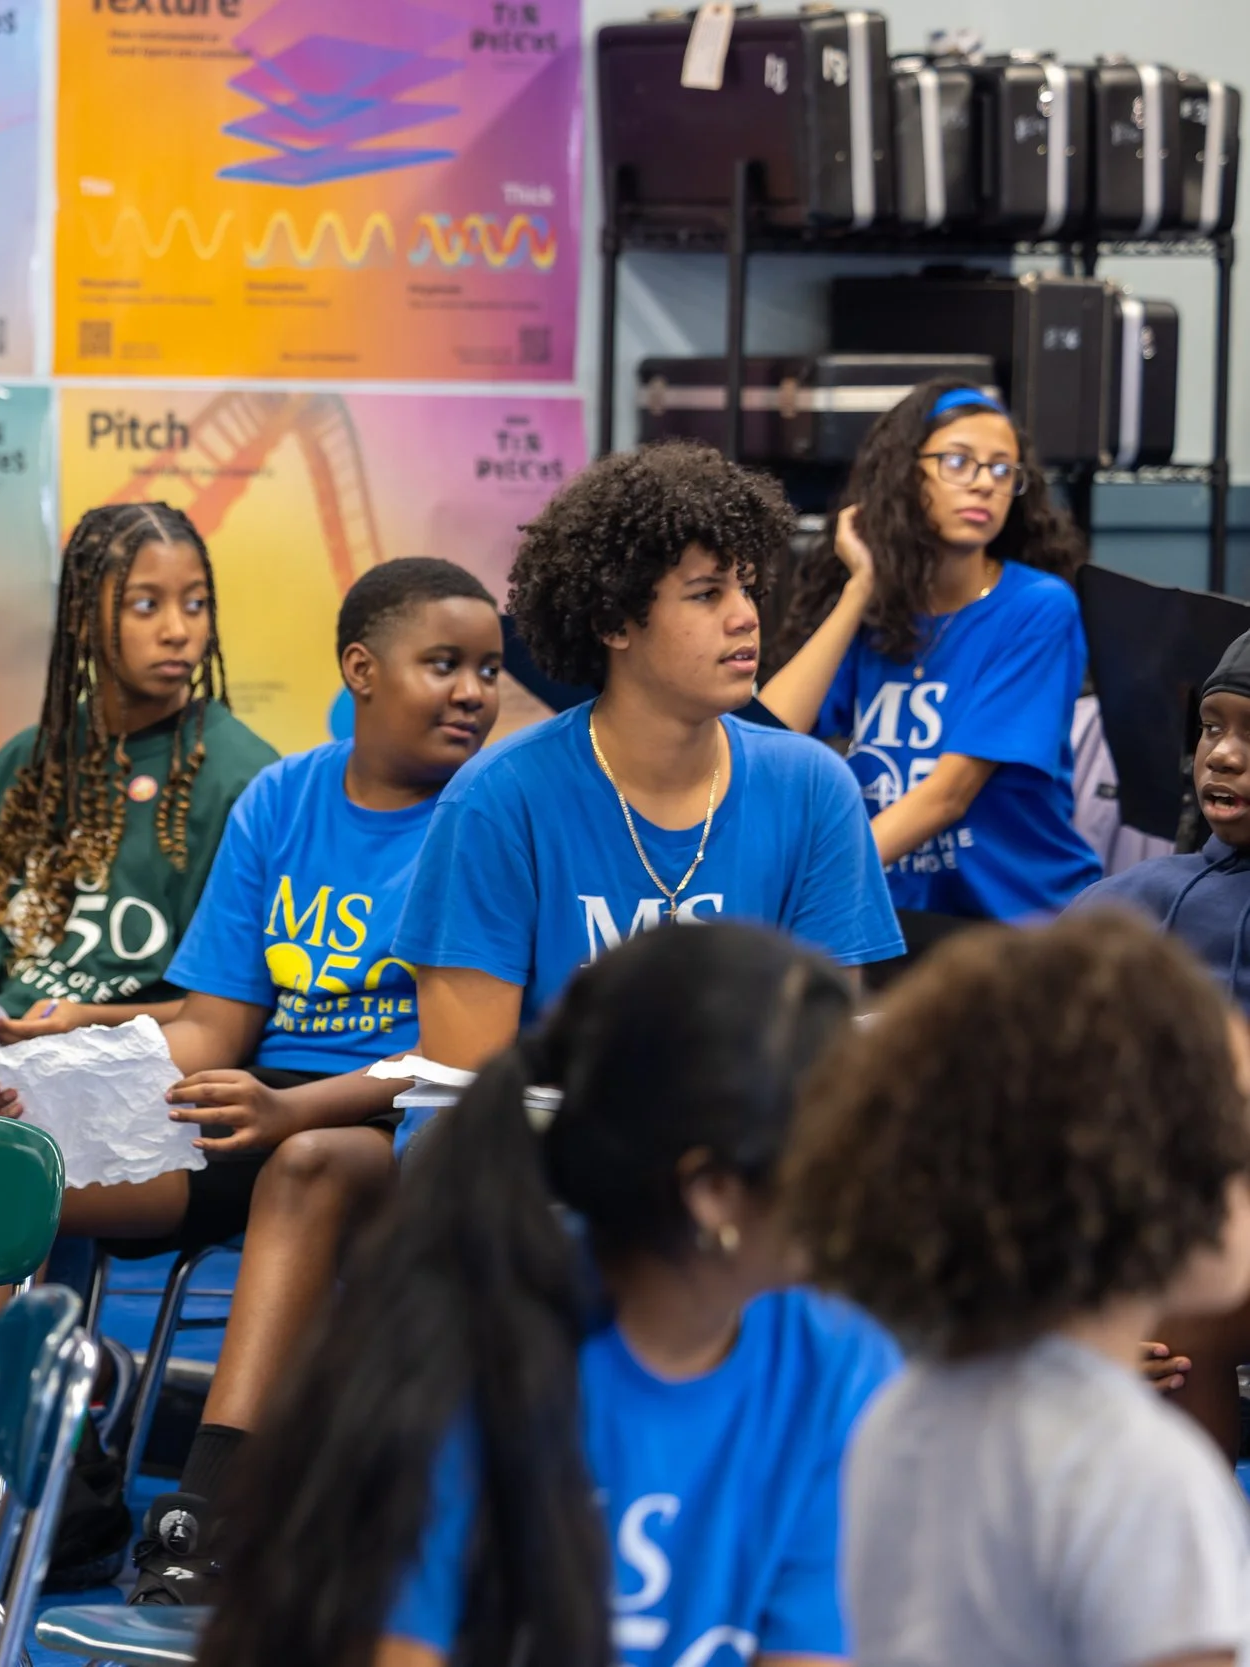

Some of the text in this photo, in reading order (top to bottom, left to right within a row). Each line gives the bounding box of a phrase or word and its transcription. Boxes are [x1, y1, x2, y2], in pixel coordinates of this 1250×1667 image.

[88, 410, 189, 451] Pitch
[64, 895, 168, 968] 50
[264, 875, 374, 953] MS
[360, 997, 413, 1014] THE
[592, 1489, 681, 1611] S
